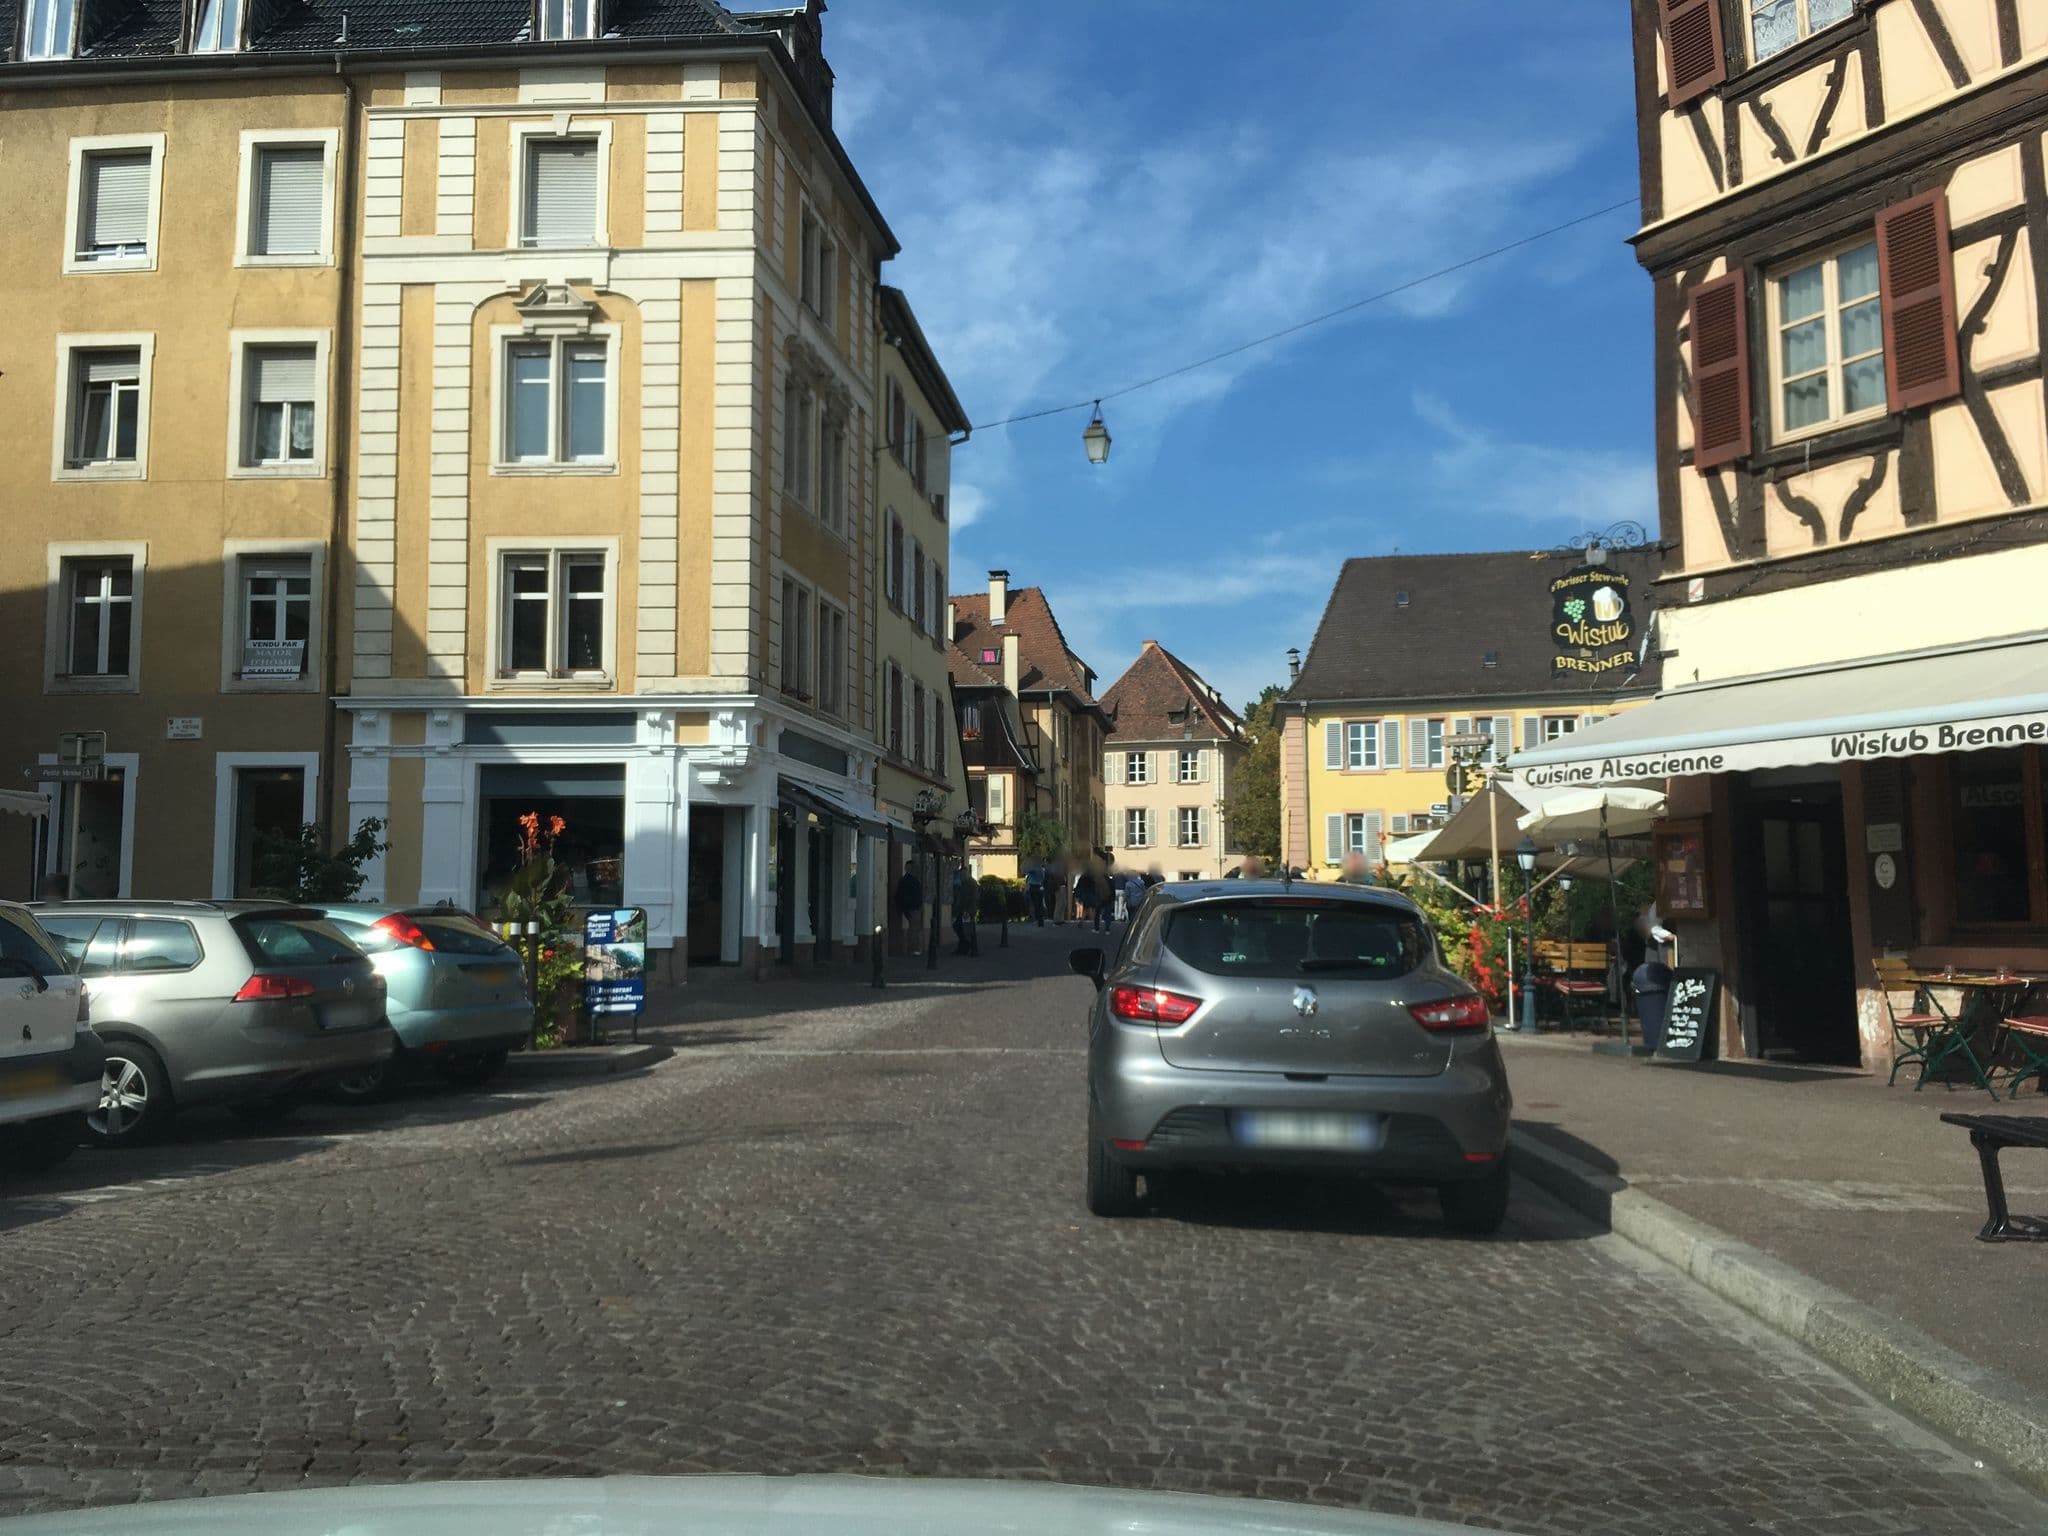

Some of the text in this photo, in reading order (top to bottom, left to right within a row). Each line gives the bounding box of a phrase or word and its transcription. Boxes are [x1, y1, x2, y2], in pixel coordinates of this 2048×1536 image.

[1556, 619, 1630, 647] Wistub
[1555, 651, 1635, 673] BRENNER
[1830, 721, 2048, 758] Wistub Brenne
[1525, 753, 1724, 786] Cuisine Alsacienne
